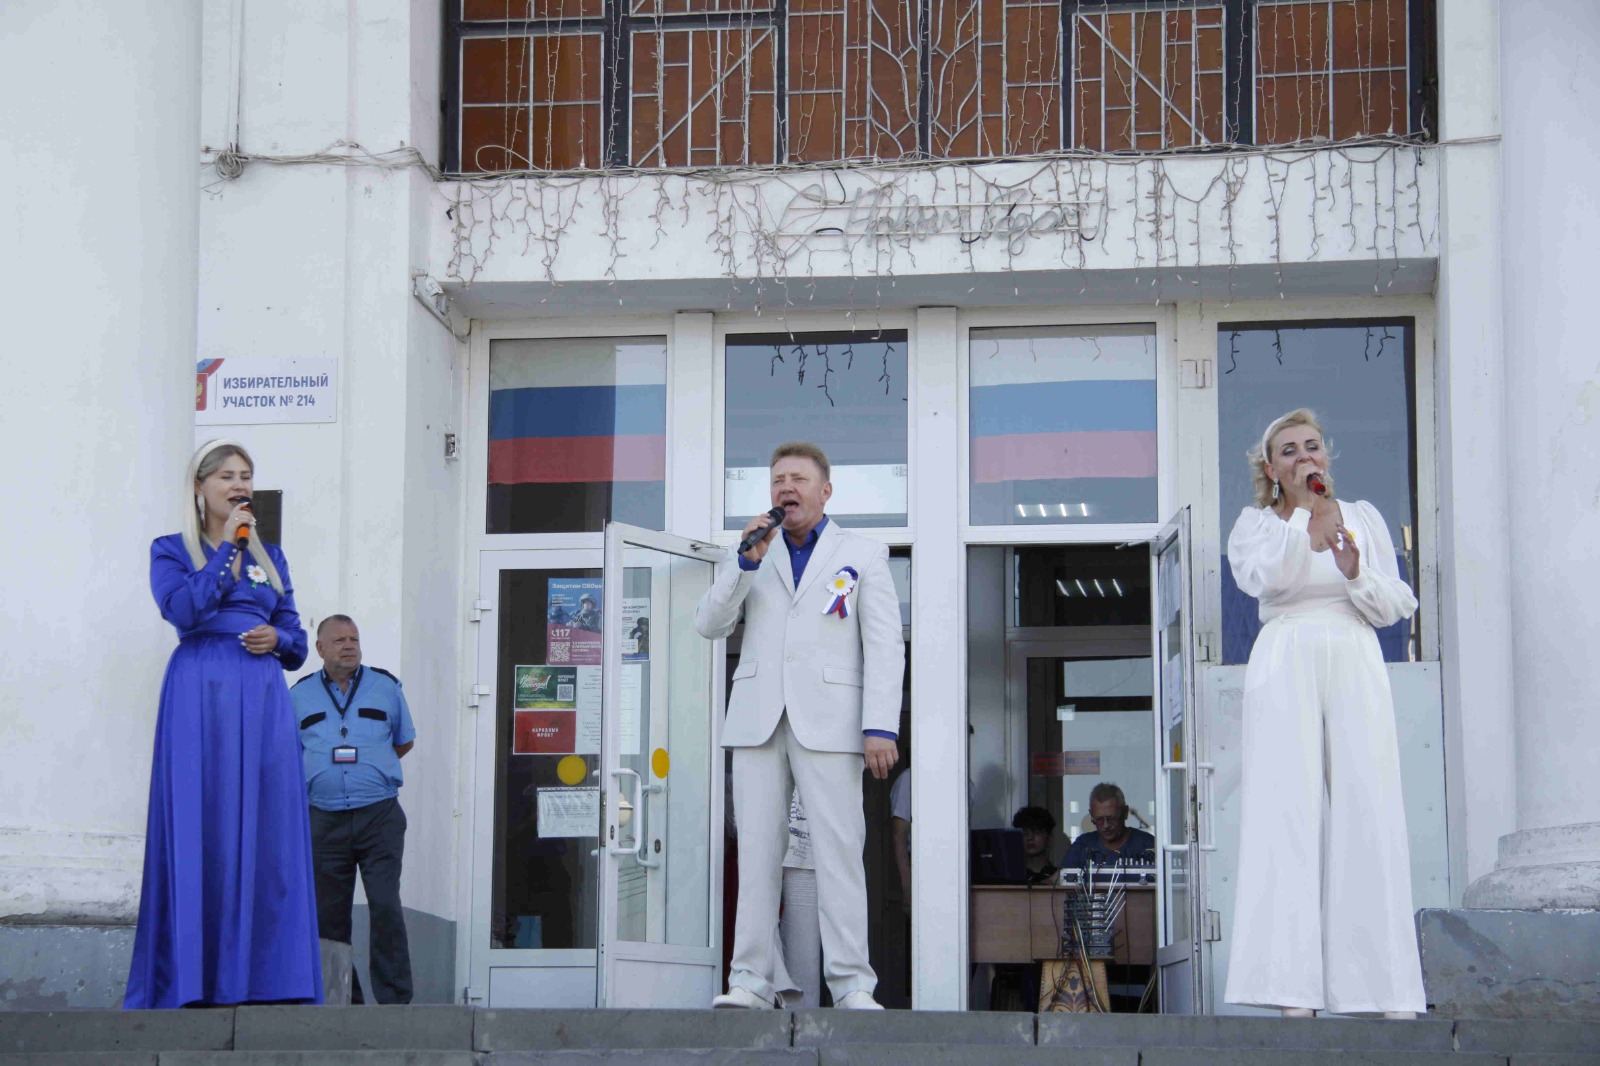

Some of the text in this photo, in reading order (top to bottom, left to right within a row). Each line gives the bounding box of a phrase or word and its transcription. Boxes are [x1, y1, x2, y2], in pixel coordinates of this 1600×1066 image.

[223, 373, 329, 389] ИЗБИРАТЕЛЬНЫЙ
[223, 394, 316, 408] УЧАСТОК № 214
[556, 628, 571, 637] 117
